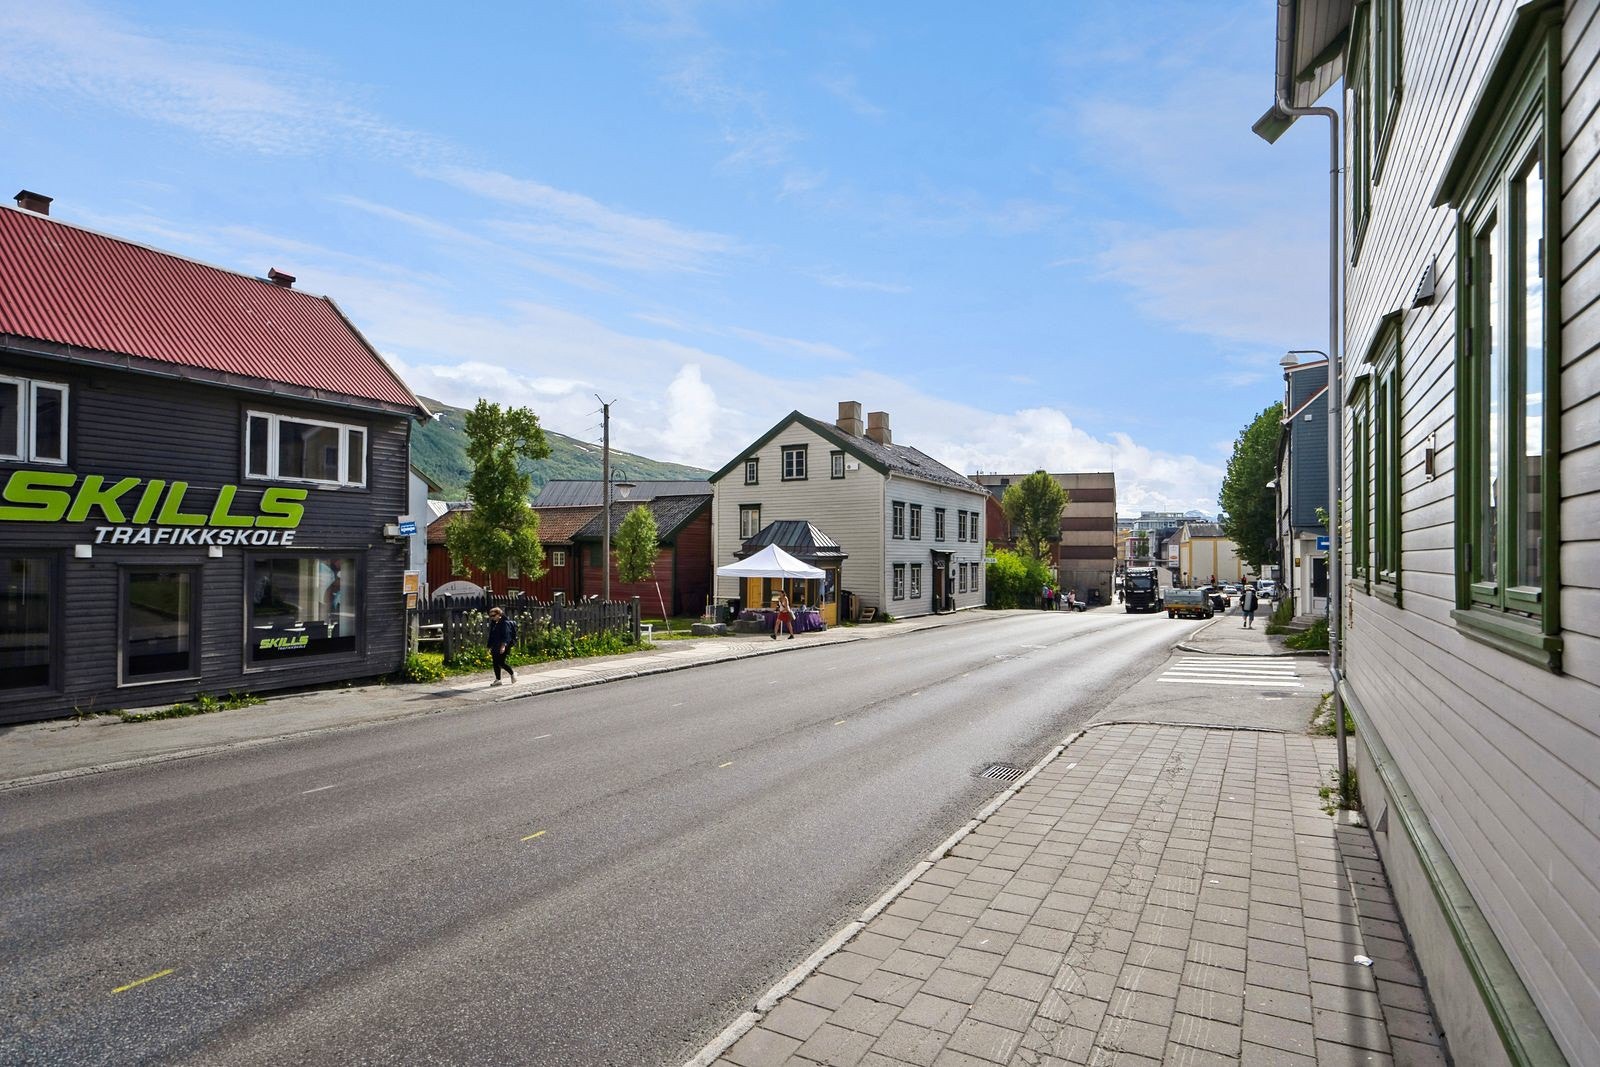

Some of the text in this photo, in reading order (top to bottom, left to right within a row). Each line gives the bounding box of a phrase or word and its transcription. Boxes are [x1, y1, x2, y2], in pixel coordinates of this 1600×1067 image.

[0, 470, 308, 528] SKILLS
[95, 526, 296, 546] TRAFIKKSKOLE
[259, 635, 309, 649] SKILLS
